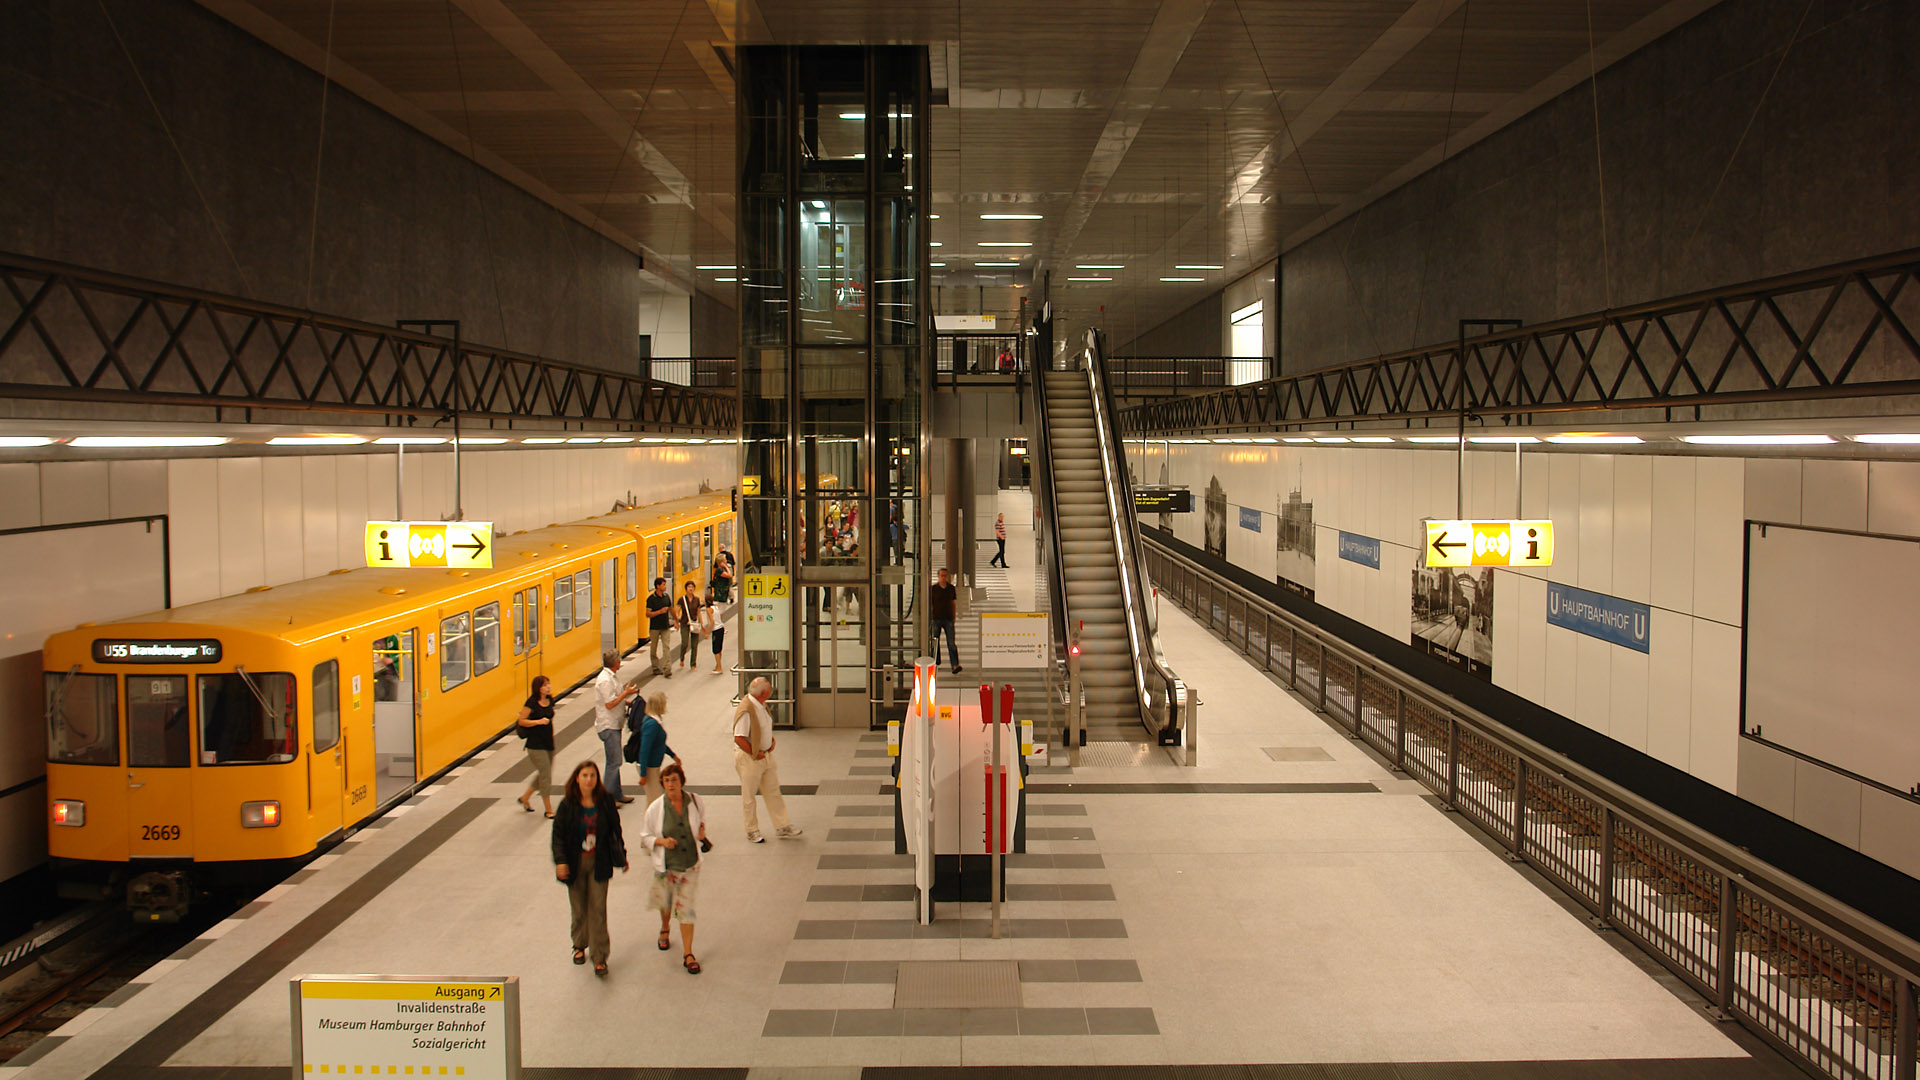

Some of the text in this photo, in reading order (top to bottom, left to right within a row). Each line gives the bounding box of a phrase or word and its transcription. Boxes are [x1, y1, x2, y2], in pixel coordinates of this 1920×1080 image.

[748, 603, 774, 611] Ausgang
[1550, 591, 1644, 640] U HAUPTBAHNHOF U
[104, 644, 216, 658] U55 Brandenburger Tor
[351, 785, 367, 806] 2669
[141, 825, 181, 841] 2669
[435, 986, 485, 999] Ausgang
[397, 1002, 486, 1014] Invalidenstraße
[318, 1018, 487, 1034] Museum Hamburger Bahnhof
[411, 1038, 487, 1052] Sozialgericht
